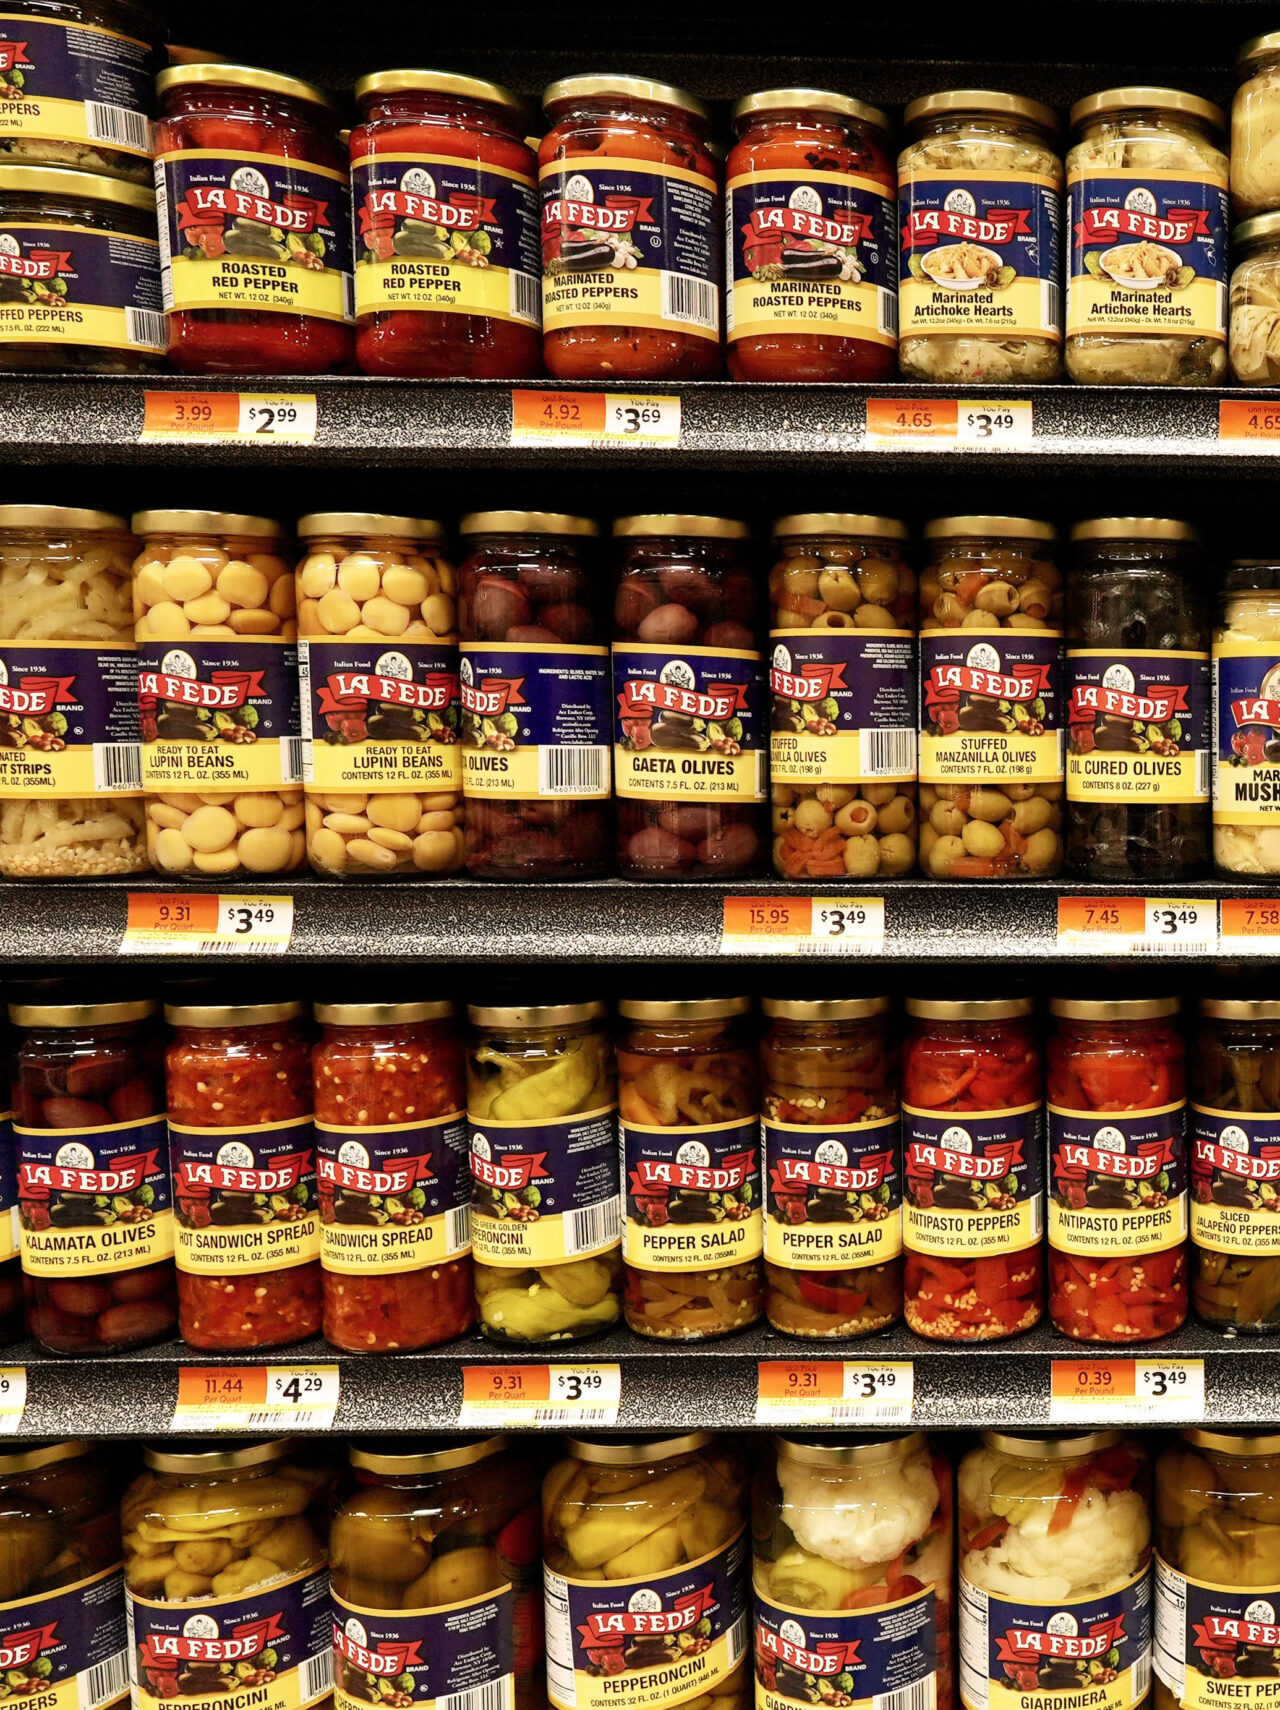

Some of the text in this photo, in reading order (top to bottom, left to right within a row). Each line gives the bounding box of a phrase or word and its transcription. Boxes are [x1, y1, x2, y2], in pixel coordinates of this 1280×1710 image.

[193, 188, 309, 229] LA FEDE
[221, 262, 287, 278] ROASTED
[212, 276, 299, 294] RED PEPPER
[770, 282, 841, 295] MARINATED
[218, 292, 233, 300] NET
[234, 292, 247, 300] WT.
[273, 295, 294, 305] (340g)
[753, 295, 862, 312] ROASTED PEPPERS
[1110, 291, 1172, 303] Marinated
[1091, 303, 1191, 317] Artichoke Hearts
[175, 406, 212, 421] 3.99
[543, 405, 580, 420] 4.92
[896, 414, 932, 427] 4.65
[338, 674, 446, 706] LA FEDE
[366, 746, 432, 755] READY TO EAT
[961, 738, 1008, 750] STUFFED
[353, 755, 443, 769] LUPINI BEANS
[935, 751, 1036, 763] MANZANILLA OLIVES
[632, 757, 734, 775] GAETA OLIVES
[1070, 760, 1182, 776] OIL CURED OLIVES
[342, 769, 453, 781] CONTENTS 12 FL. OZ. (355 ML)
[159, 907, 191, 922] 9.31
[749, 910, 789, 924] 15.95
[1085, 910, 1119, 924] 7.45
[1245, 910, 1279, 925] 7.58
[26, 1165, 136, 1190] LA FEDE
[909, 1210, 1020, 1231] ANTIPASTO PEPPERS
[26, 1225, 156, 1251] KALAMATA OLIVES
[179, 1221, 315, 1249] HOT SANDWICH SPREAD
[643, 1228, 745, 1250] PEPPER SALAD
[205, 1379, 243, 1393] 11.44
[1078, 1371, 1112, 1386] 0.39
[597, 1605, 697, 1632] LA FEDE
[603, 1656, 706, 1694] PEPPERONCINI
[1206, 1680, 1252, 1696] SWEET
[1021, 1689, 1107, 1710] GIARDINIERA
